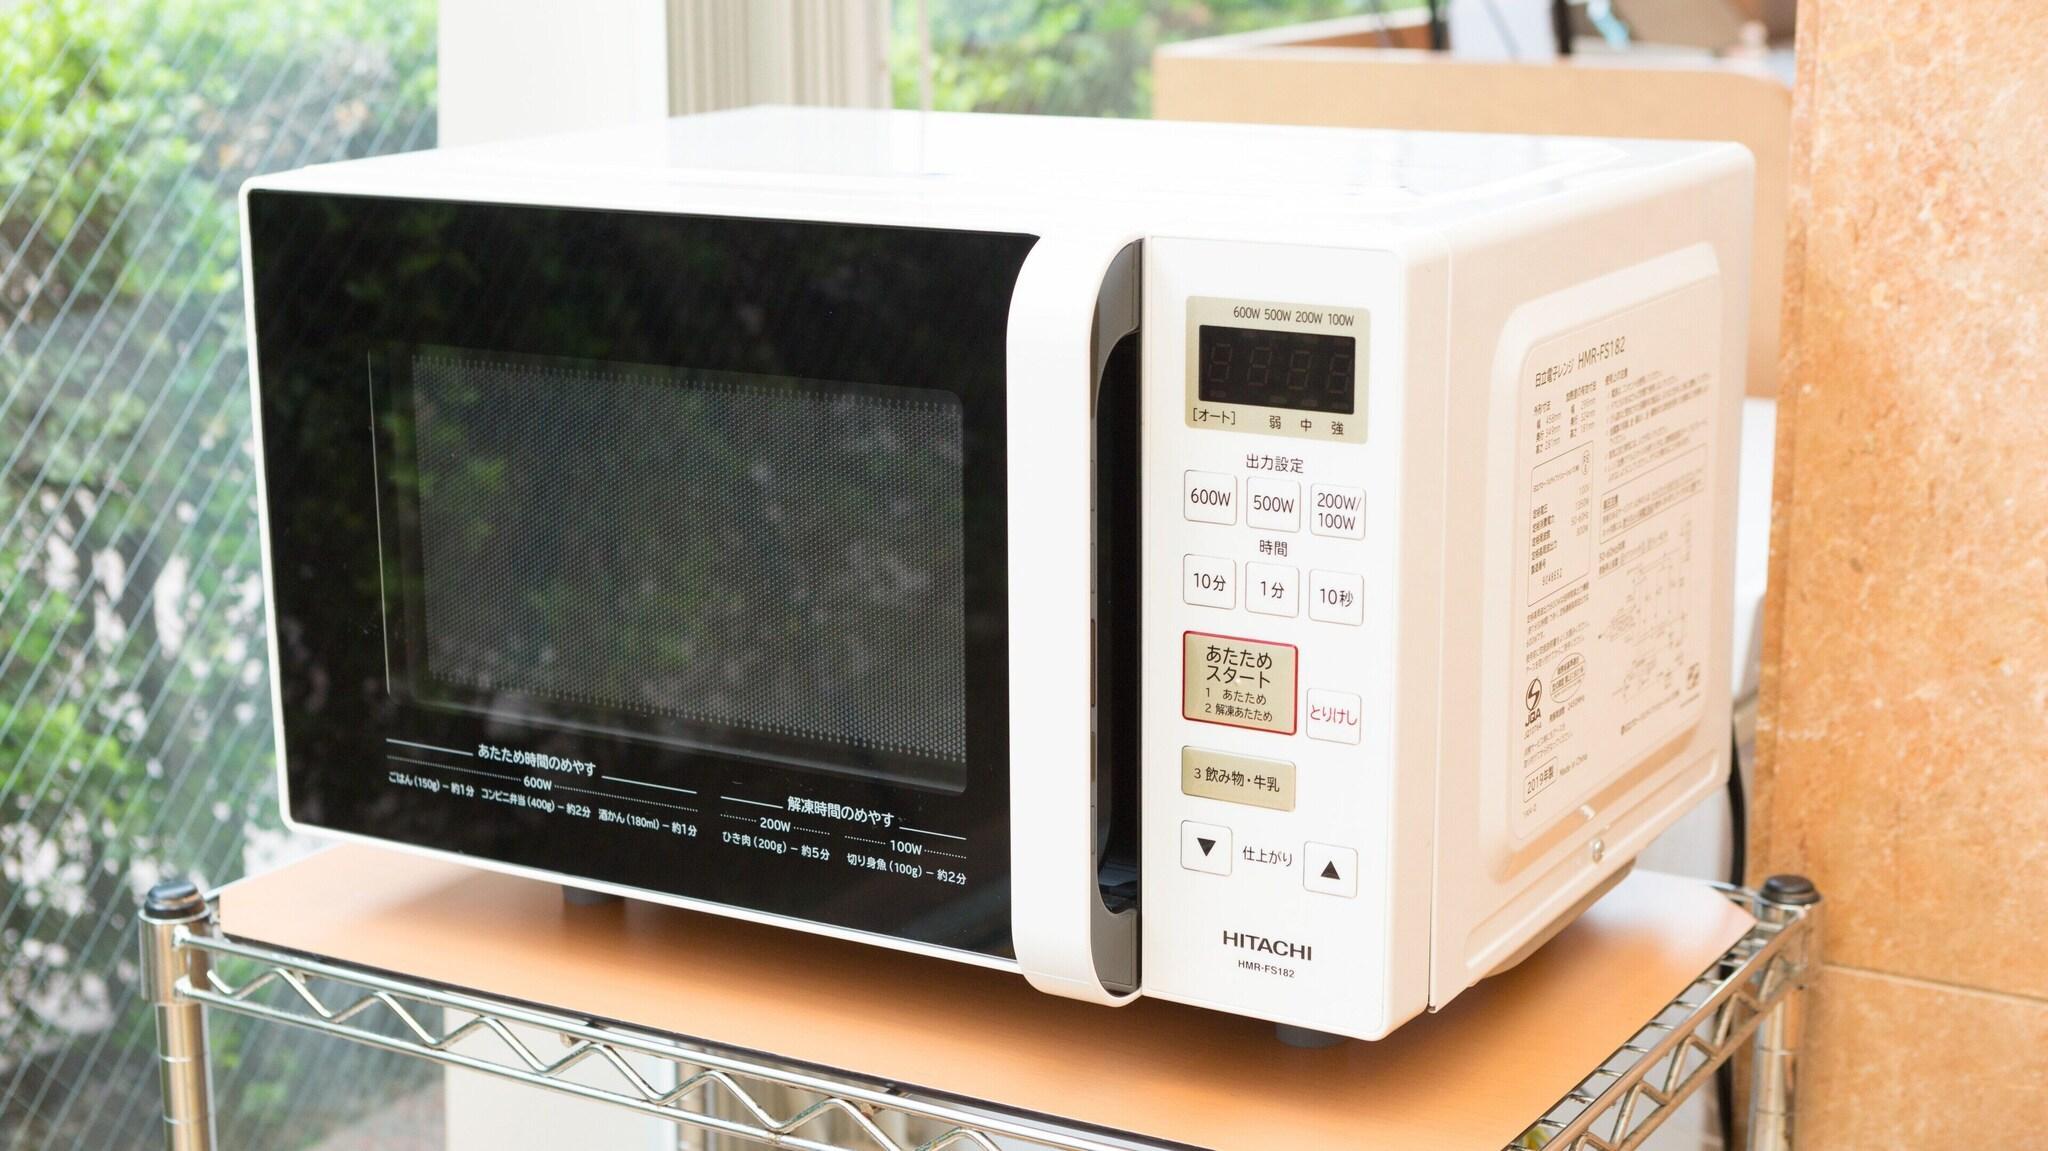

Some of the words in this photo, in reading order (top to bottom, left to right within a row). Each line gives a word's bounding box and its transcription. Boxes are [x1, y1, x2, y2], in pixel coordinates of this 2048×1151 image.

[1233, 306, 1260, 320] 600W
[1264, 308, 1292, 322] 500W
[1295, 311, 1323, 324] 200W
[1327, 313, 1355, 326] 100W
[1577, 336, 1625, 370] HMR-FS182
[1269, 415, 1282, 430] 弱
[1300, 418, 1312, 432] 中
[1331, 421, 1344, 435] 強
[1246, 453, 1304, 474] 出力設定
[1190, 488, 1231, 507] 600W
[1253, 495, 1295, 514] 500W
[1317, 492, 1362, 511] 200W/
[1318, 513, 1356, 531] 100W
[1259, 539, 1288, 557] 時間
[1193, 572, 1226, 592] 10分
[1319, 588, 1354, 607] 10秒
[1206, 644, 1273, 671] あたため
[1206, 665, 1271, 689] スタート
[1222, 689, 1267, 706] あたため
[1215, 703, 1273, 723] 解凍あたため
[1310, 704, 1358, 726] とりけし
[1525, 708, 1541, 727] JQA
[477, 743, 596, 777] あたため時間のめやす
[523, 776, 552, 791] 600W
[1205, 766, 1281, 793] 飲み物・牛乳
[787, 796, 895, 828] 解凍時間のめやす
[759, 817, 791, 833] 200W
[889, 839, 922, 856] 100W
[1243, 845, 1293, 867] 仕上がり
[1223, 930, 1312, 961] HITACHI
[1238, 959, 1295, 979] HMR-FS182
